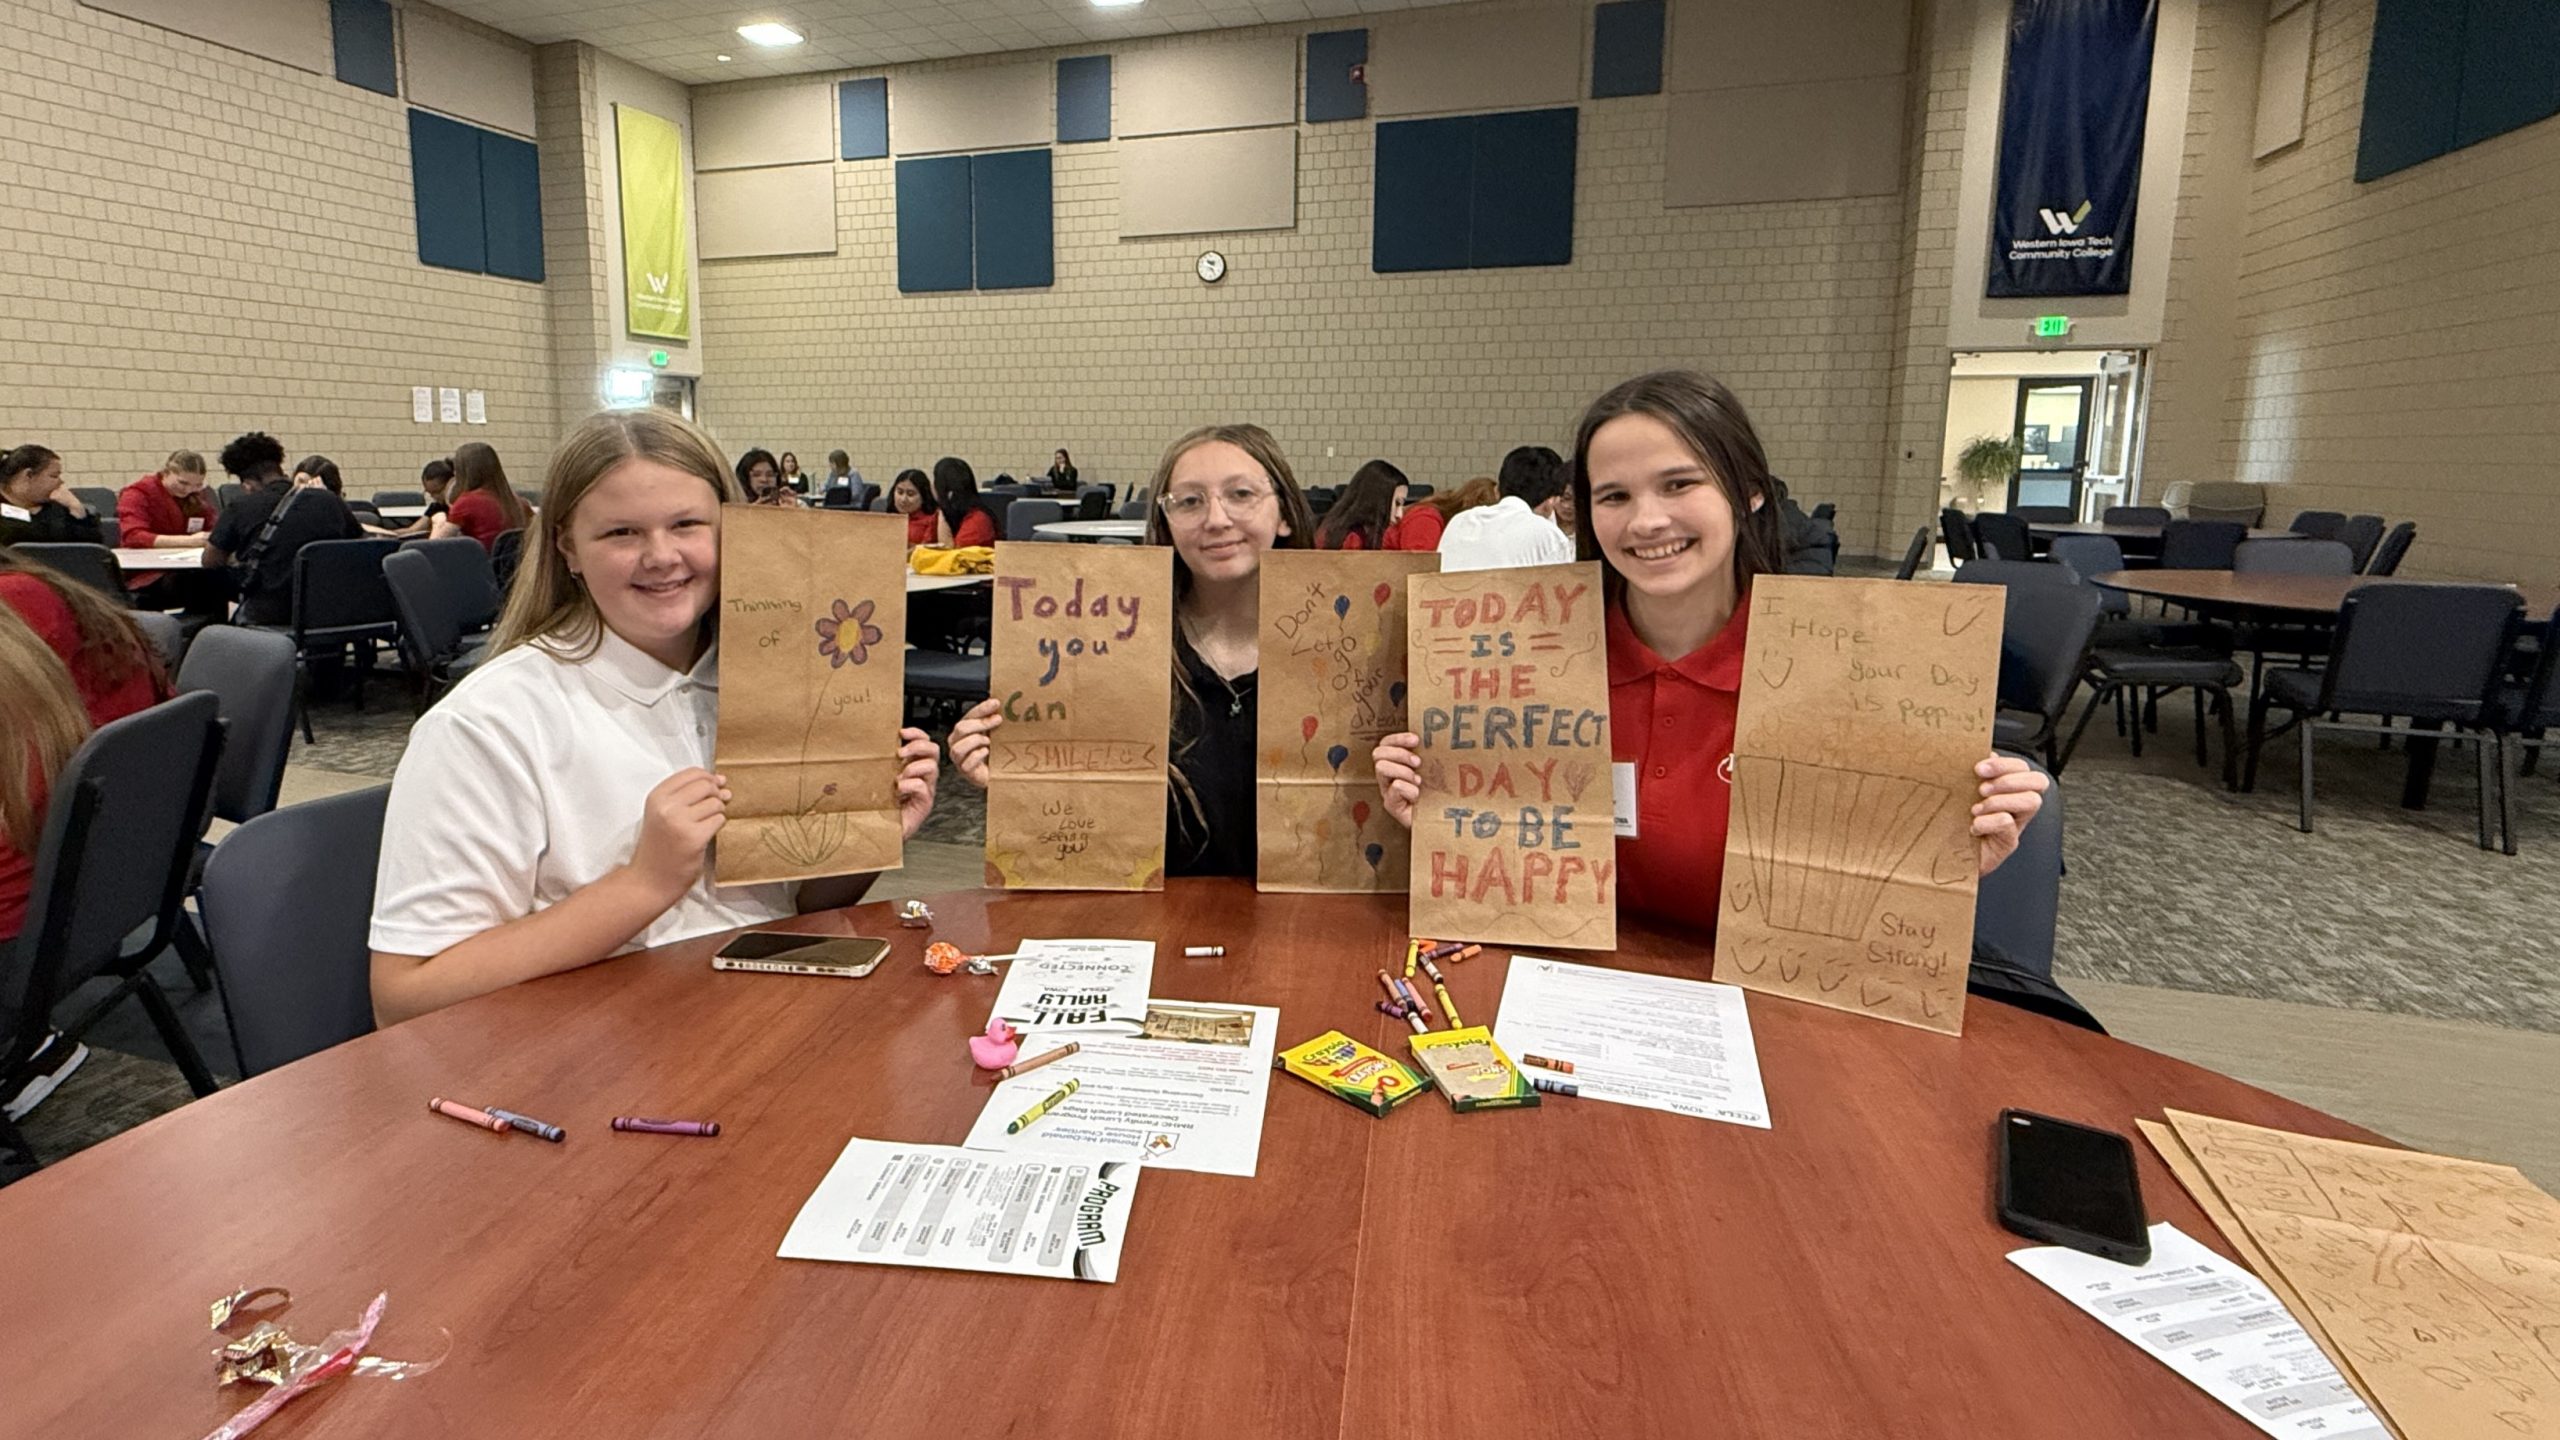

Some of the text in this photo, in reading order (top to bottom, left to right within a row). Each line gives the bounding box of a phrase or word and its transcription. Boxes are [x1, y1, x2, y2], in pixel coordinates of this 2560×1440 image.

[2008, 246, 2114, 260] Community College
[2012, 235, 2113, 249] Western Iowa Tech
[996, 577, 1140, 642] Today
[1274, 582, 1326, 640] Don't
[1419, 582, 1589, 629] TODAY
[1759, 596, 1784, 616] I
[1470, 631, 1517, 658] IS
[1790, 617, 1873, 650] Hope
[1038, 636, 1110, 687] you
[1333, 636, 1357, 674] go
[1446, 664, 1537, 701] THE
[1931, 663, 1981, 697] Day
[833, 688, 871, 716] you!
[1004, 691, 1067, 724] Can
[1423, 704, 1608, 751] PERFECT
[1024, 743, 1111, 771] SMILE!
[1458, 757, 1559, 803] DAY
[1042, 800, 1074, 816] We
[1444, 806, 1581, 850] TO BE
[1055, 842, 1085, 861] you
[1431, 846, 1615, 906] HAPPY
[1881, 911, 1937, 949] Stay
[1037, 962, 1131, 974] CONNECTED
[1867, 940, 1948, 978] Strong!
[1037, 993, 1108, 1006] RALLY
[1302, 1039, 1346, 1064] Crayola
[1062, 1105, 1180, 1122] Decorated Lunch Bags
[1089, 1115, 1122, 1124] Lunch
[1124, 1116, 1160, 1127] Family
[1161, 1121, 1195, 1130] RMHC
[1040, 1130, 1140, 1147] Ronald McDonald
[1105, 1131, 1142, 1141] House
[1076, 1181, 1122, 1249] PROGRAM
